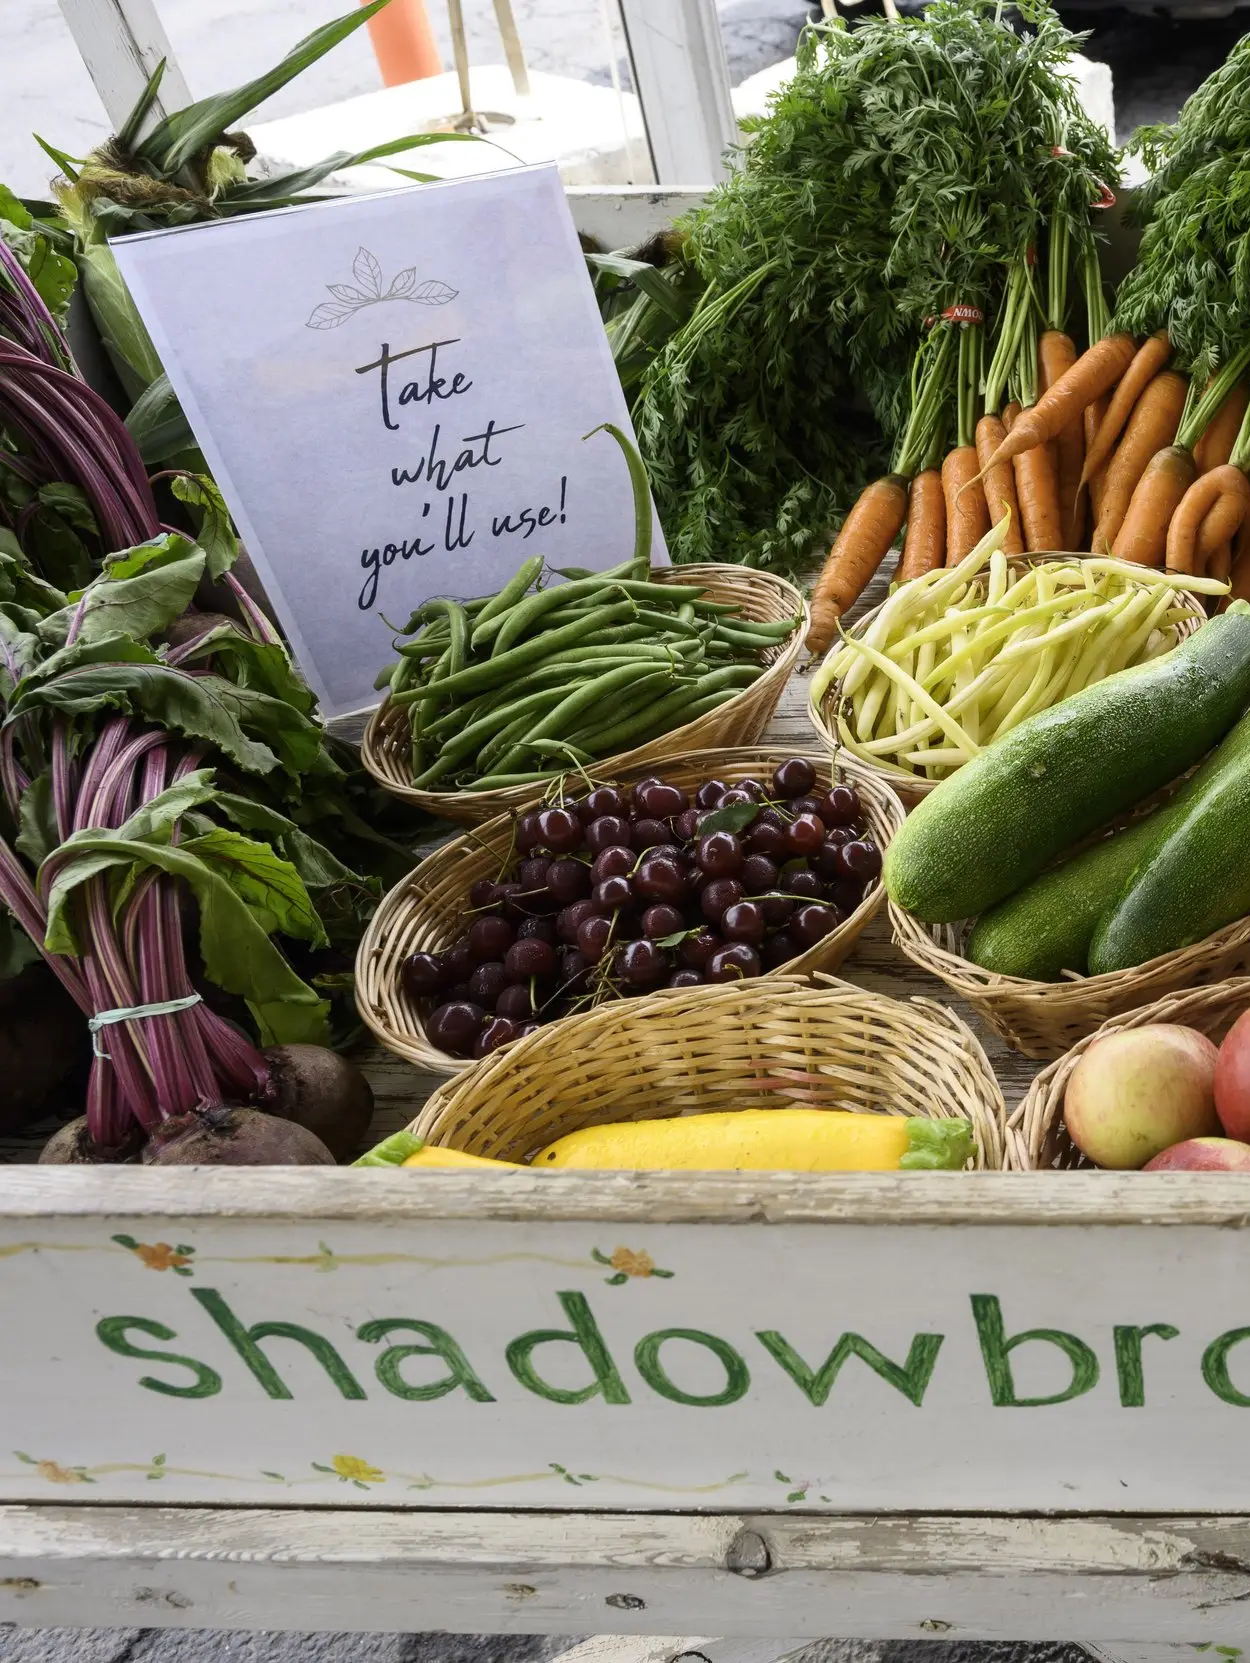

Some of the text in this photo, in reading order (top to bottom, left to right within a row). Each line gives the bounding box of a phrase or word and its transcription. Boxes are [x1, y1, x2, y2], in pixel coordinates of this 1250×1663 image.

[355, 339, 472, 430] Take
[391, 420, 526, 491] what
[358, 476, 567, 610] you'll use!
